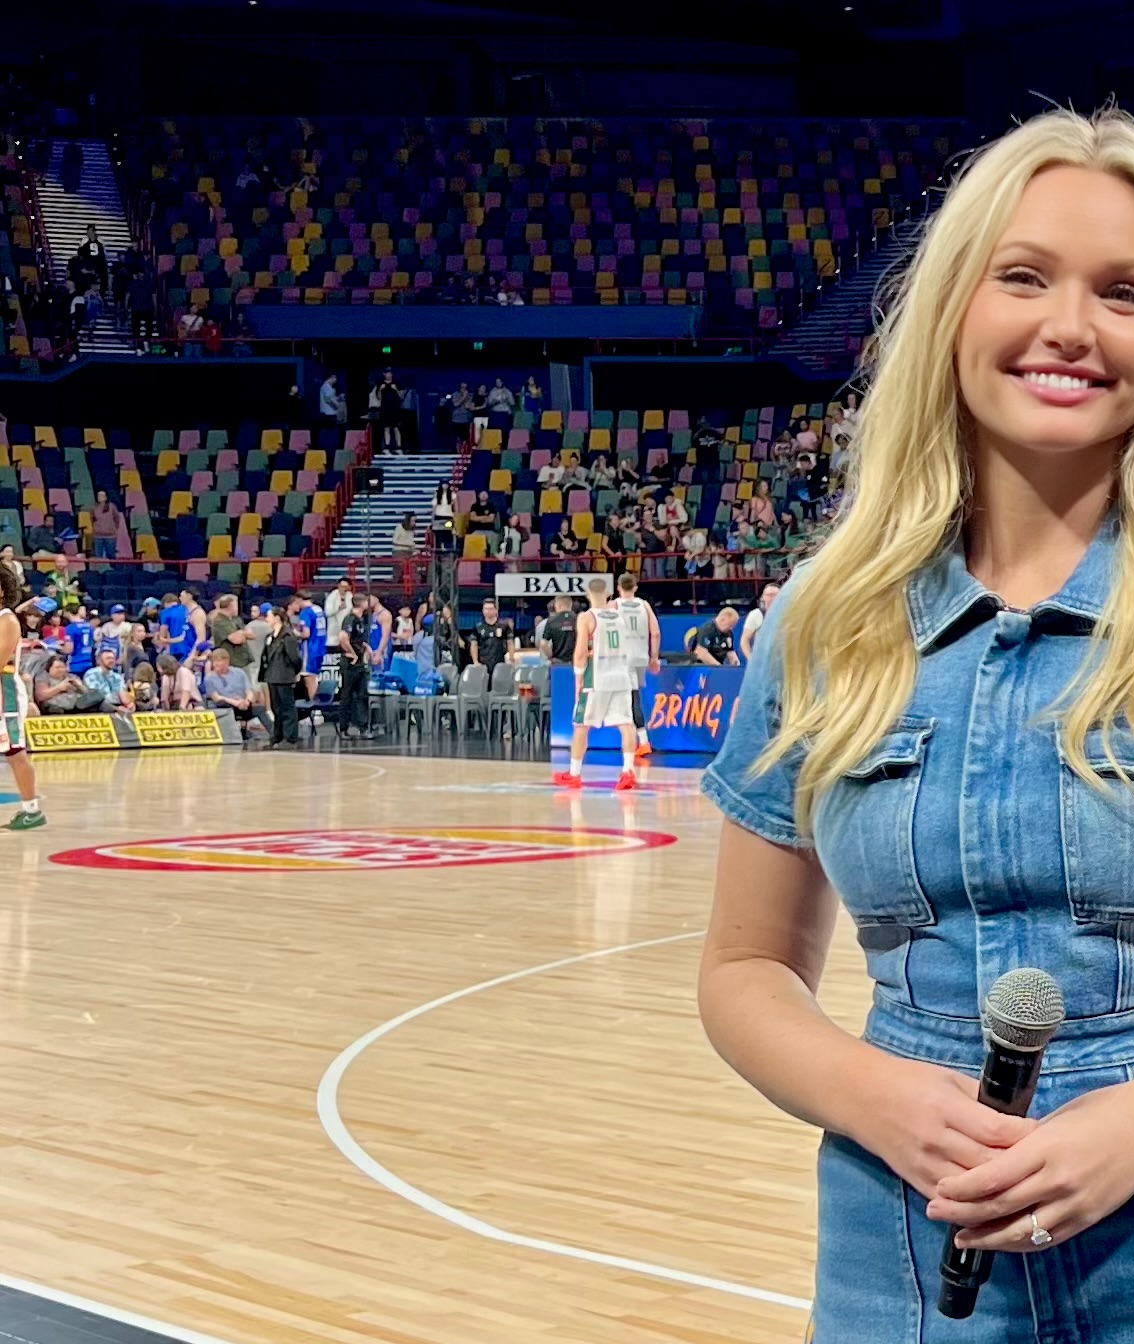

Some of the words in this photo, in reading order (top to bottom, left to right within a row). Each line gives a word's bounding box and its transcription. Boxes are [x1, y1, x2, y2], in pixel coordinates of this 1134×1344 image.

[523, 576, 587, 594] BAR
[606, 630, 620, 649] 10
[137, 711, 214, 727] NATIONAL
[646, 692, 723, 738] BRING
[26, 717, 111, 731] NATIONAL
[35, 732, 111, 746] STORAGE
[143, 727, 216, 742] STORAGE
